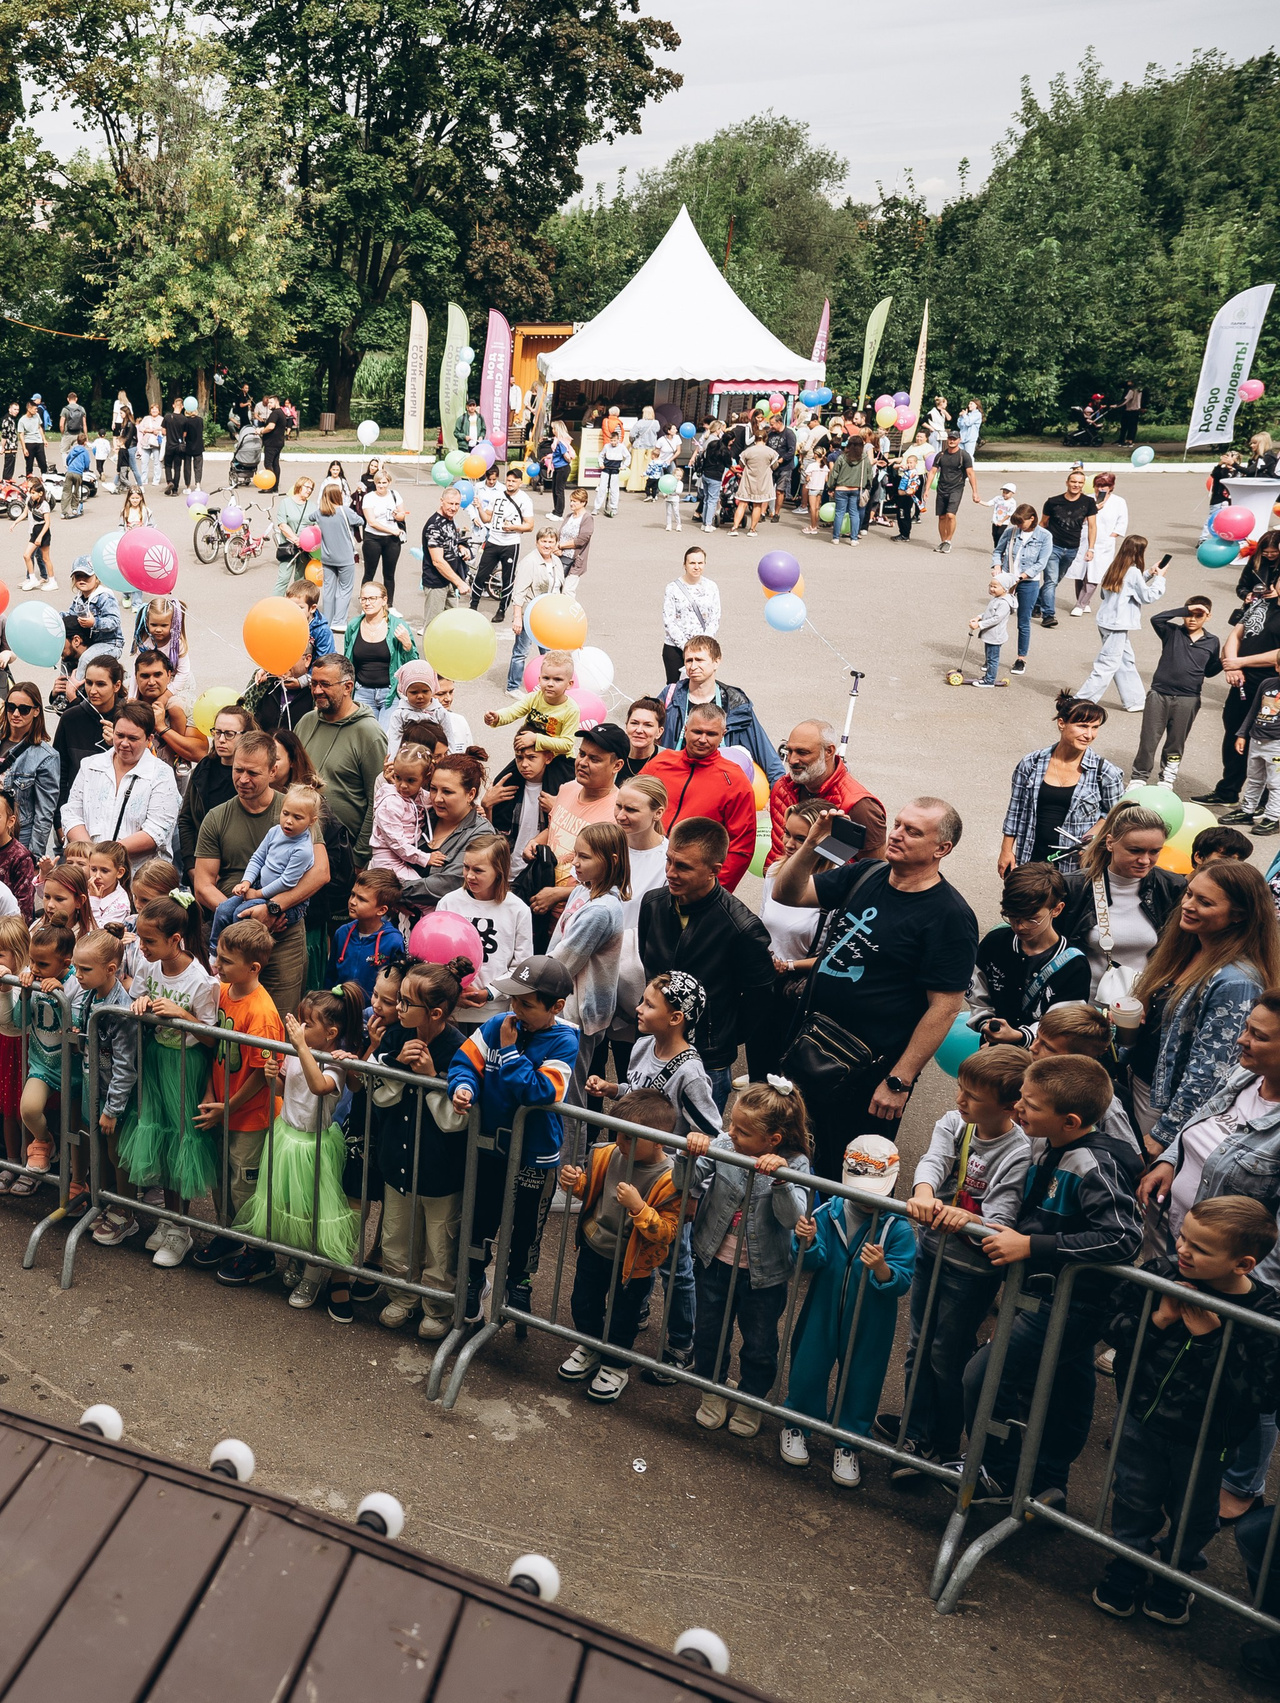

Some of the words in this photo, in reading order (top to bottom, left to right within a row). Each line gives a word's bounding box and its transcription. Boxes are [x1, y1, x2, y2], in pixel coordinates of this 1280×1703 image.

[1215, 341, 1249, 432] пожаловать!
[1198, 387, 1220, 433] Добро
[1053, 952, 1071, 968] NIKE
[1040, 964, 1056, 983] NIKE
[1027, 979, 1042, 998] NIKE
[520, 1182, 540, 1190] JEANS
